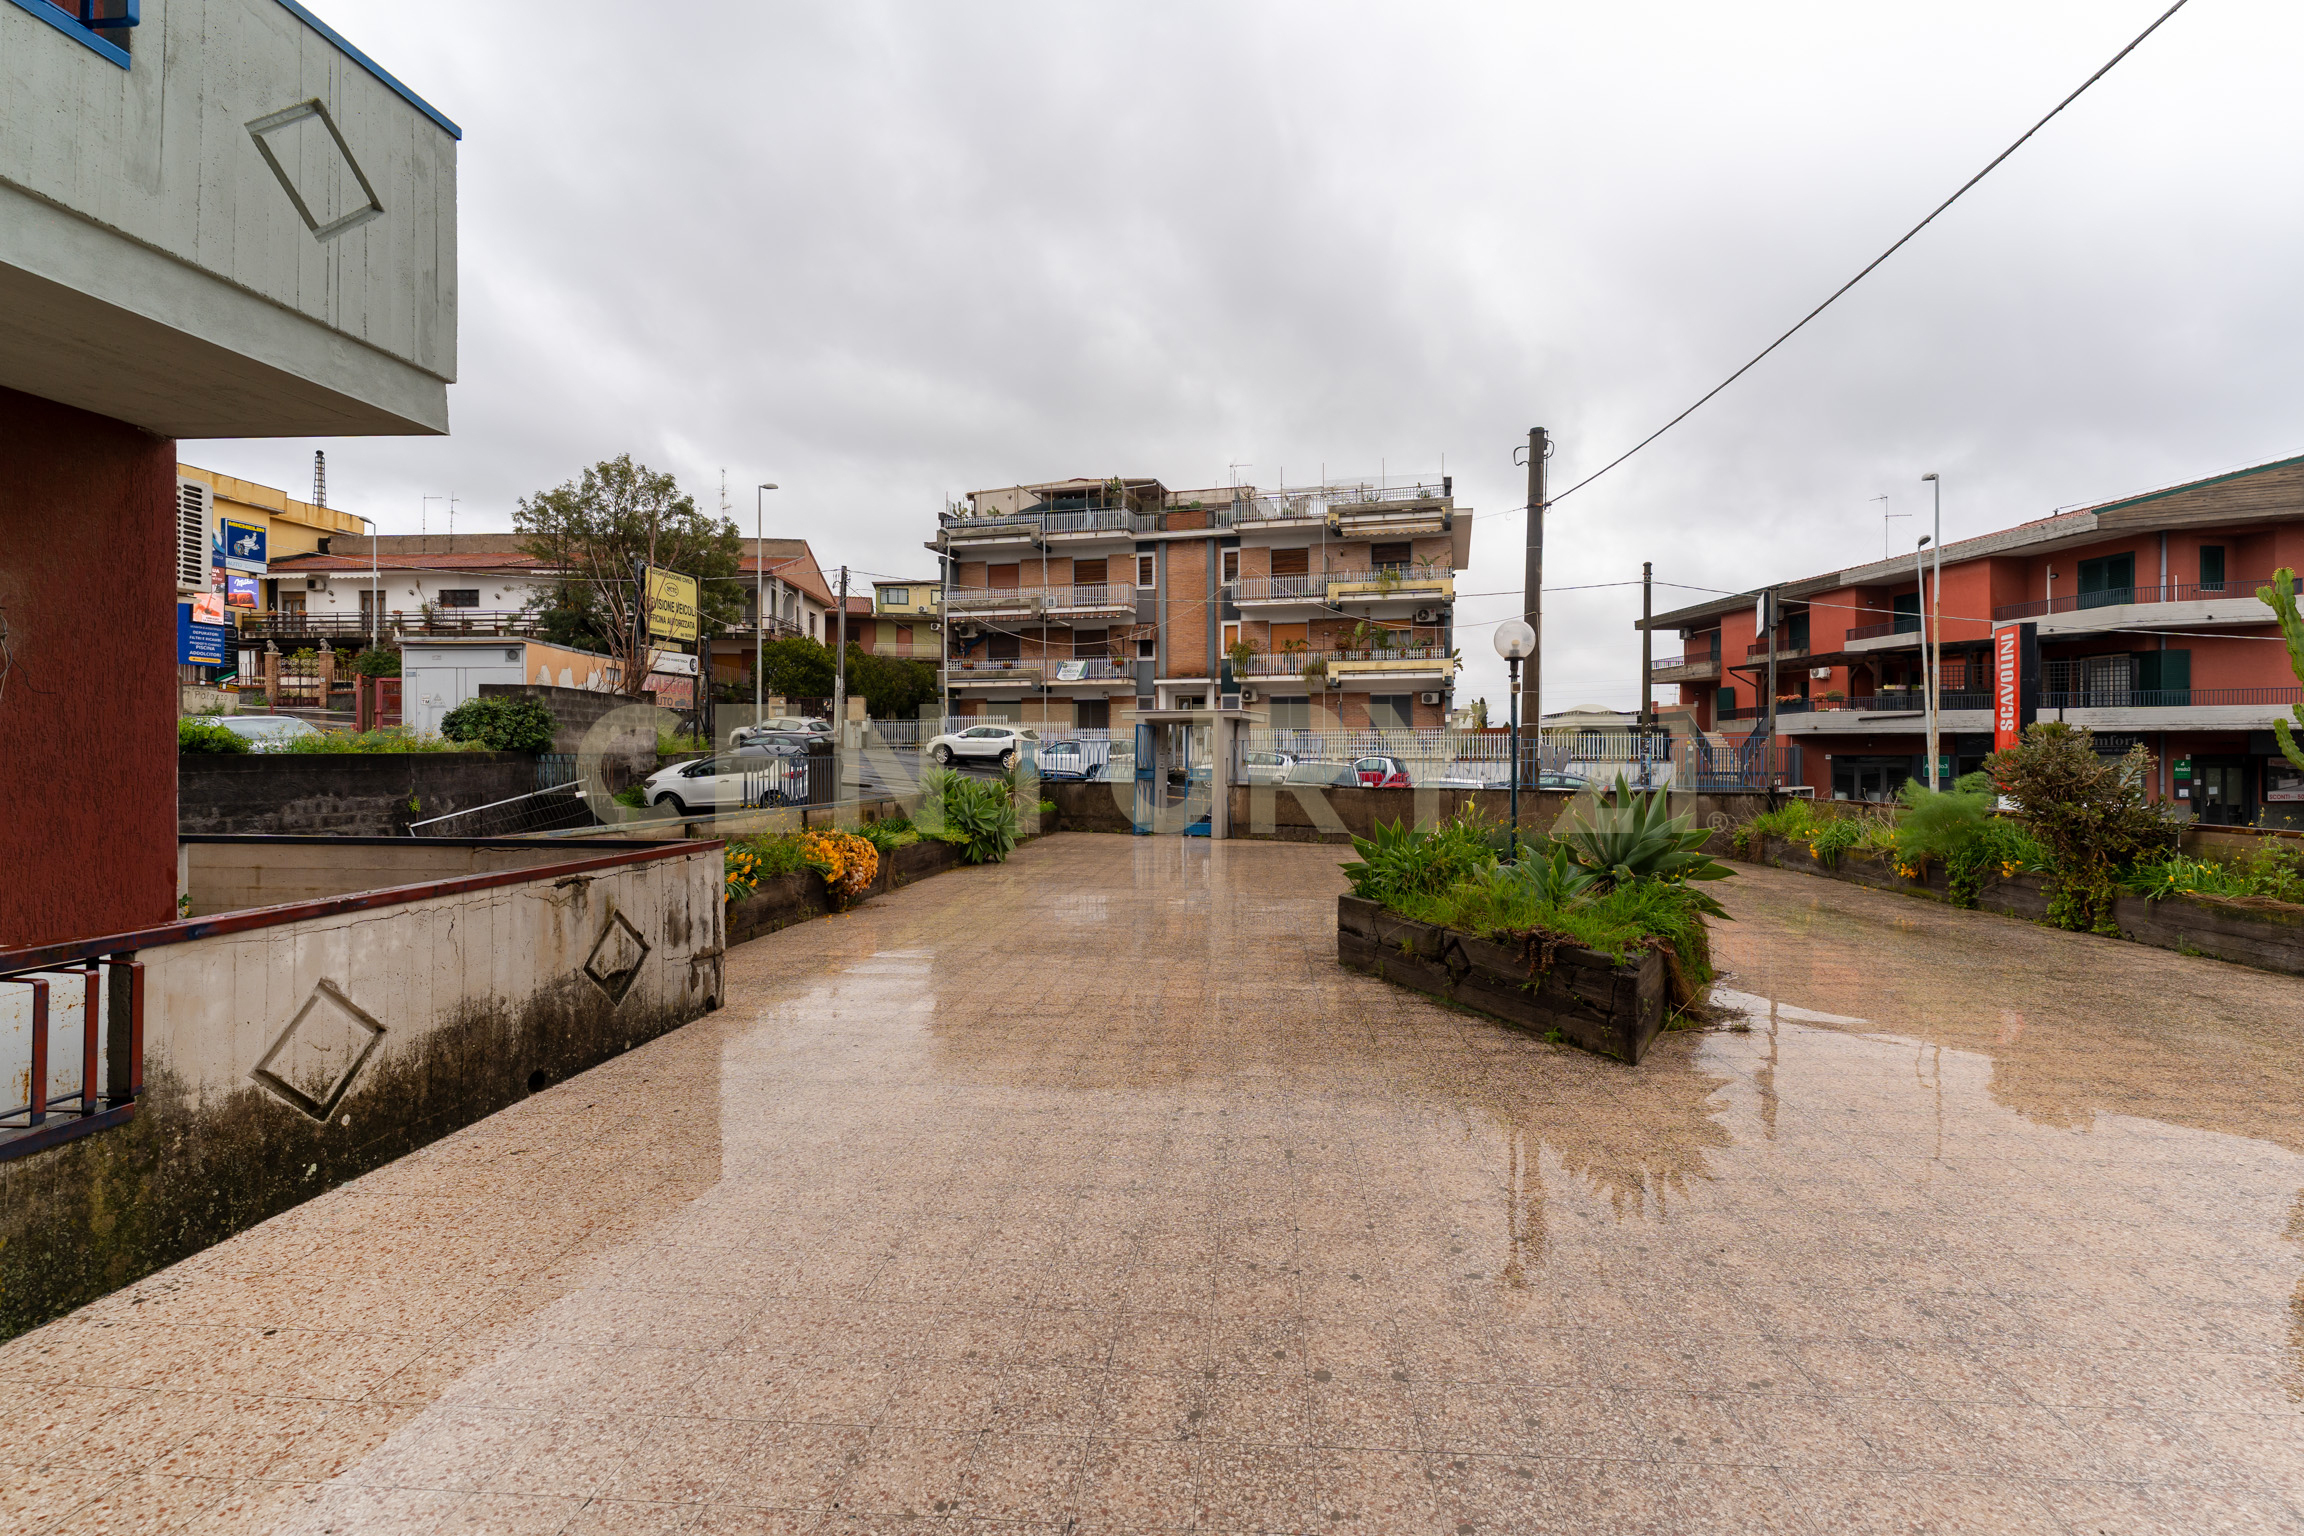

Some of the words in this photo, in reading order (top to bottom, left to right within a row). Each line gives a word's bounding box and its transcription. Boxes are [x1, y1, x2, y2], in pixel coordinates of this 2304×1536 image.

[228, 521, 265, 533] MICHELIN
[234, 578, 254, 587] Milka
[675, 602, 697, 617] VEICOLI
[2000, 633, 2015, 732] SCAVOLINI
[656, 696, 673, 706] UTO
[2094, 735, 2137, 746] mfort
